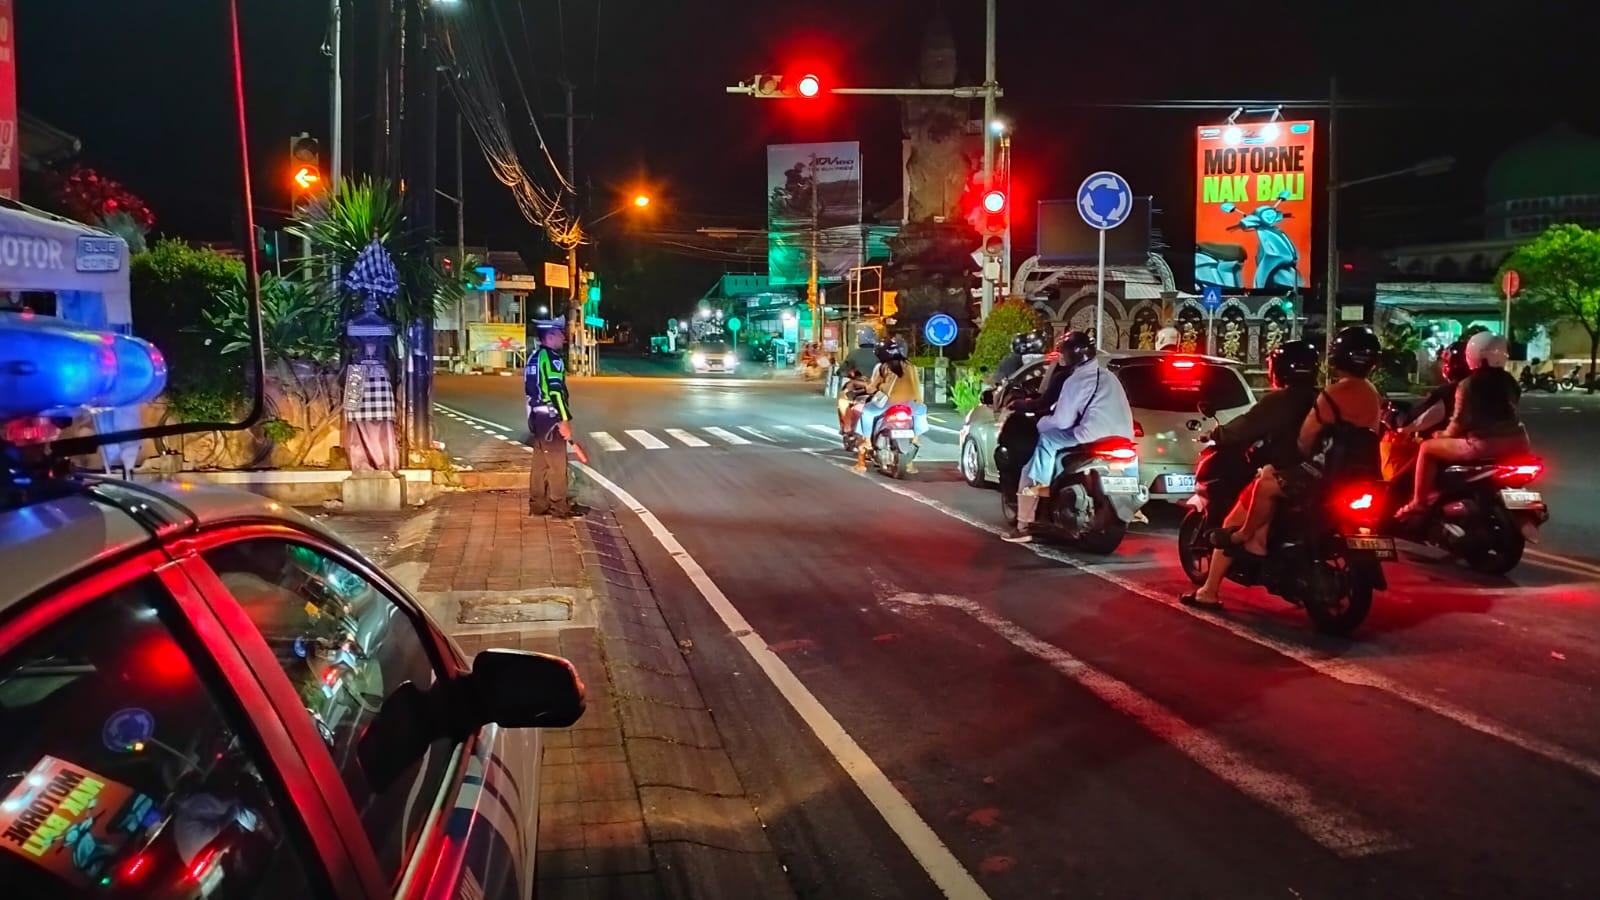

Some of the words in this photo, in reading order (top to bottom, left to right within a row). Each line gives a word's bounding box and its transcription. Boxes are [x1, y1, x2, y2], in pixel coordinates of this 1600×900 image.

[1204, 146, 1304, 175] MOTORNE
[1203, 175, 1249, 203] NAK
[1257, 174, 1304, 201] BALI
[0, 236, 63, 269] OTOR
